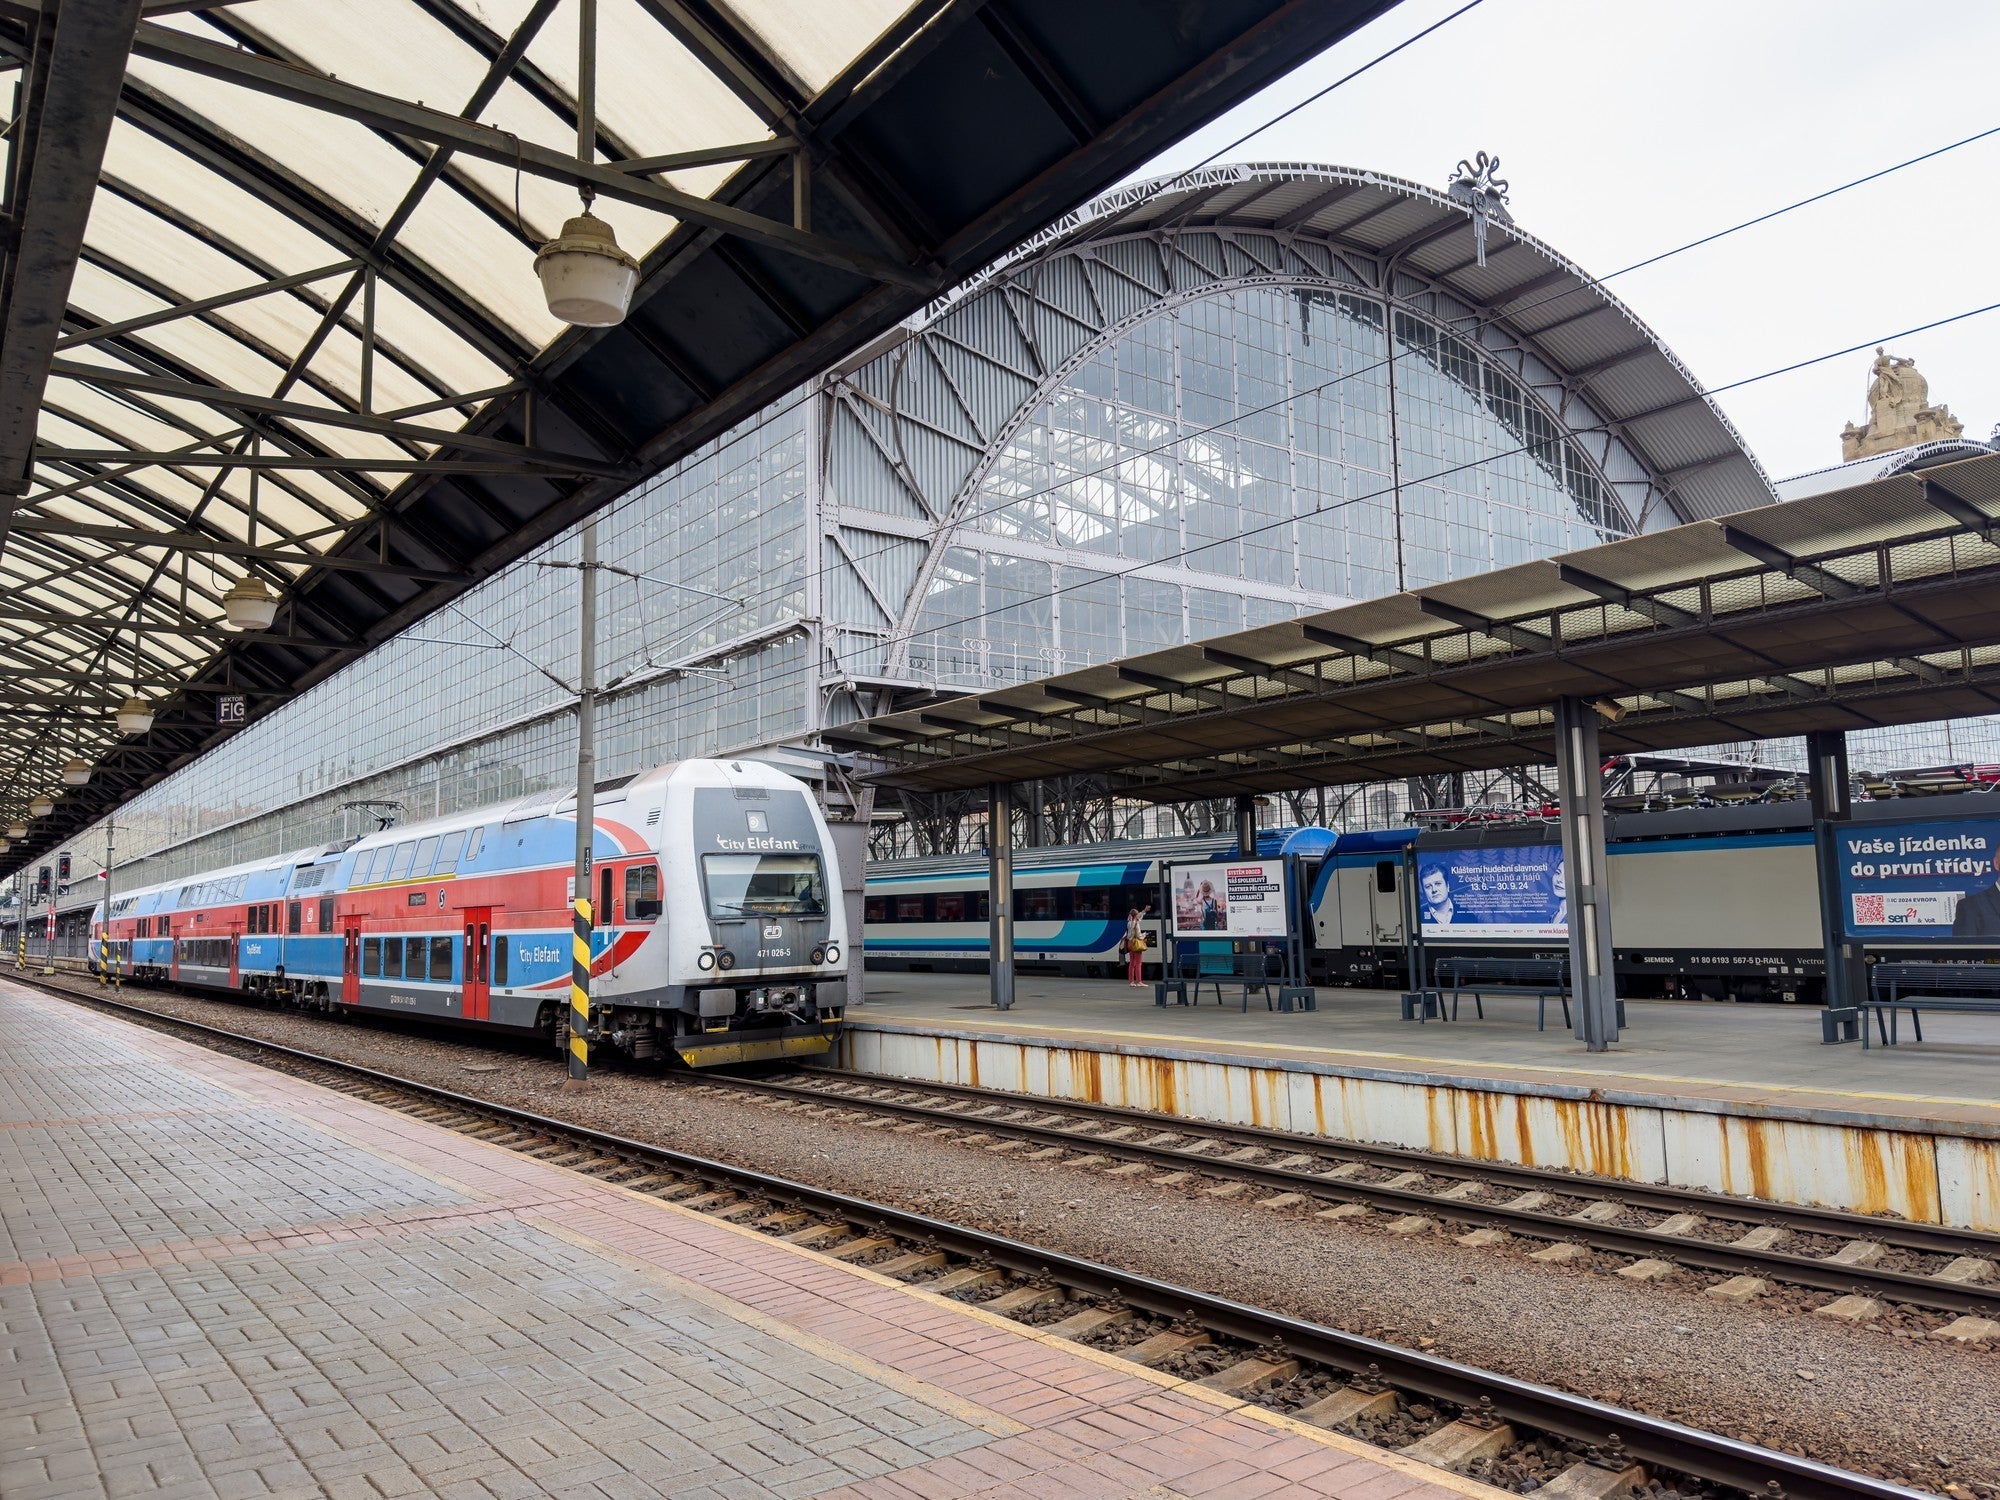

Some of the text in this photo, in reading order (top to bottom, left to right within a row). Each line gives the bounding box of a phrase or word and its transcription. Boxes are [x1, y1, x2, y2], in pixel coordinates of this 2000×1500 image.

[221, 702, 245, 717] F G
[717, 834, 745, 850] City
[747, 837, 800, 850] Elefant
[1848, 835, 1987, 856] Vaše jízdenka
[1483, 864, 1513, 873] hudební
[1514, 863, 1548, 872] slavnosti
[1850, 858, 1992, 879] do první třídy:
[1465, 873, 1495, 883] českých
[1496, 872, 1515, 882] luhů
[1522, 873, 1541, 883] hájů
[1519, 881, 1529, 890] 24
[534, 946, 560, 963] Elefant
[771, 949, 791, 957] 026-5
[1755, 957, 1785, 965] D-RAILL
